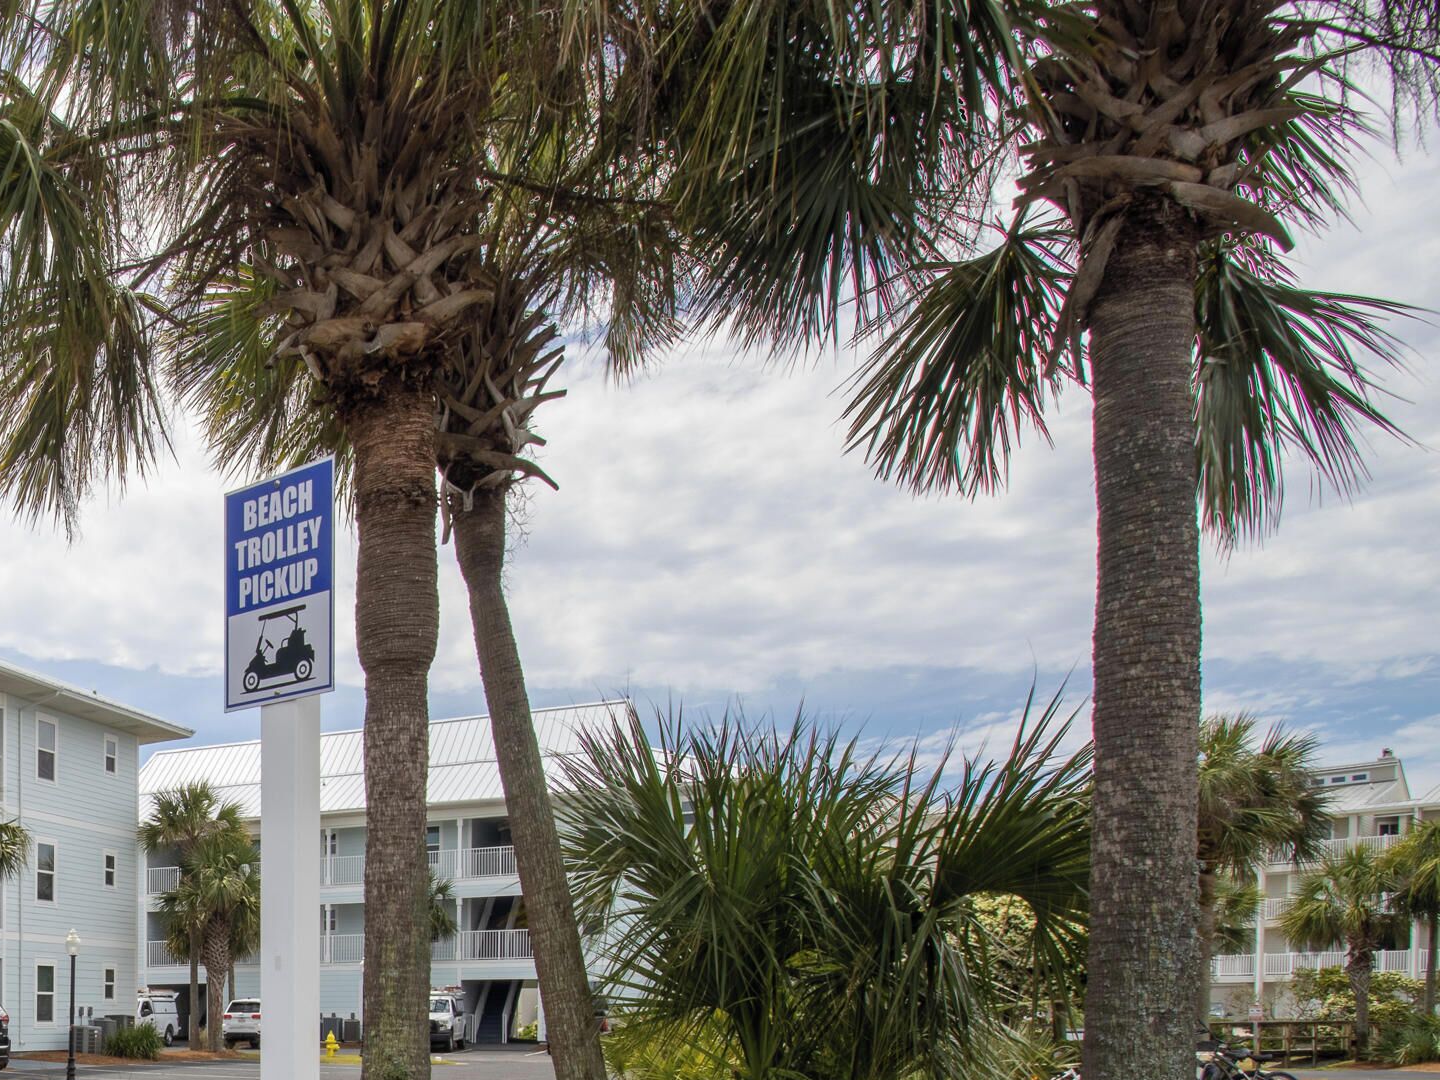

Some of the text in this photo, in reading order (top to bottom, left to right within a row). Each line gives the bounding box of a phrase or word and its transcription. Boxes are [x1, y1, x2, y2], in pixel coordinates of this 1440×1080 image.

[243, 479, 313, 532] BEACH
[235, 515, 322, 571] TROLLEY
[239, 557, 318, 609] PICKUP
